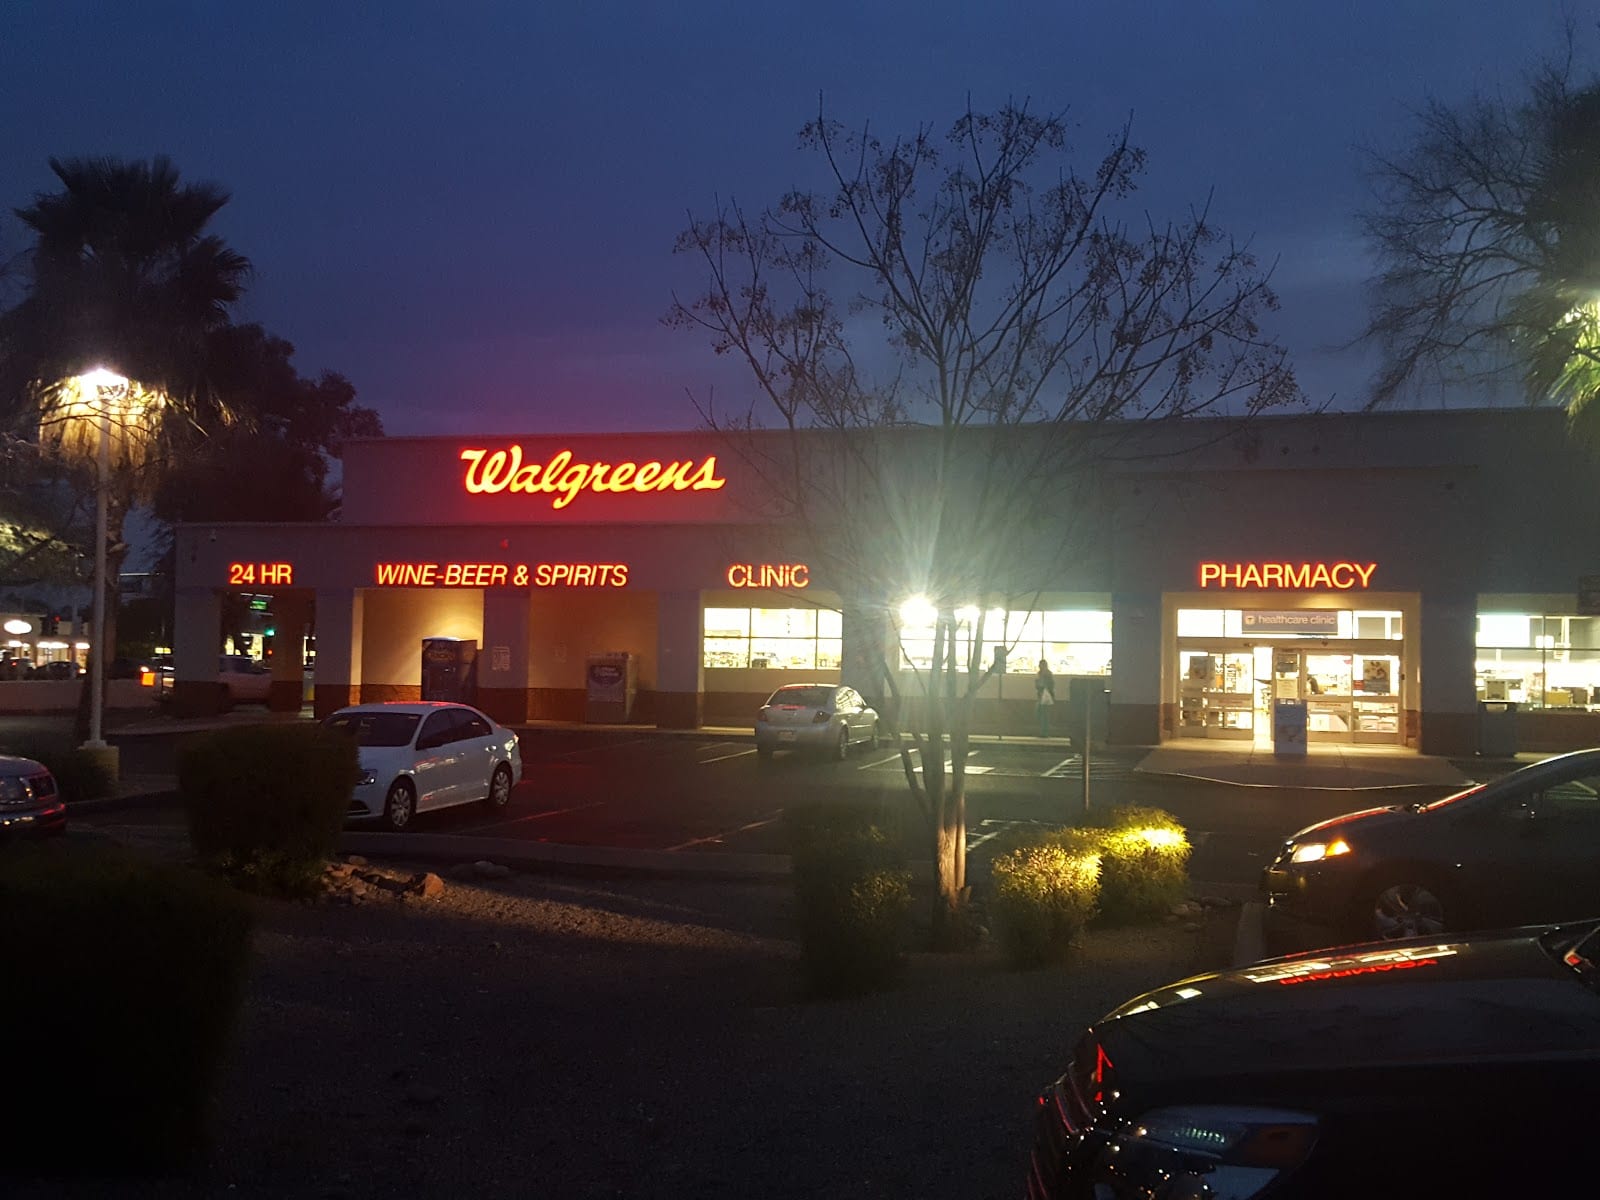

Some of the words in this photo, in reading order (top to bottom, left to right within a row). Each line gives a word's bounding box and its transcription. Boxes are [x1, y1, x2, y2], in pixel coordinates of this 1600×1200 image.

[459, 443, 727, 510] Walgreens
[229, 563, 256, 585] 24
[259, 563, 293, 585] HR
[376, 563, 508, 587] WINE-BEER
[512, 563, 530, 587] &
[534, 563, 629, 588] SPIRITS
[726, 563, 810, 589] CLINIC
[1198, 562, 1378, 590] PHARMACY
[1258, 615, 1308, 625] healthcare
[1310, 615, 1335, 625] clinic
